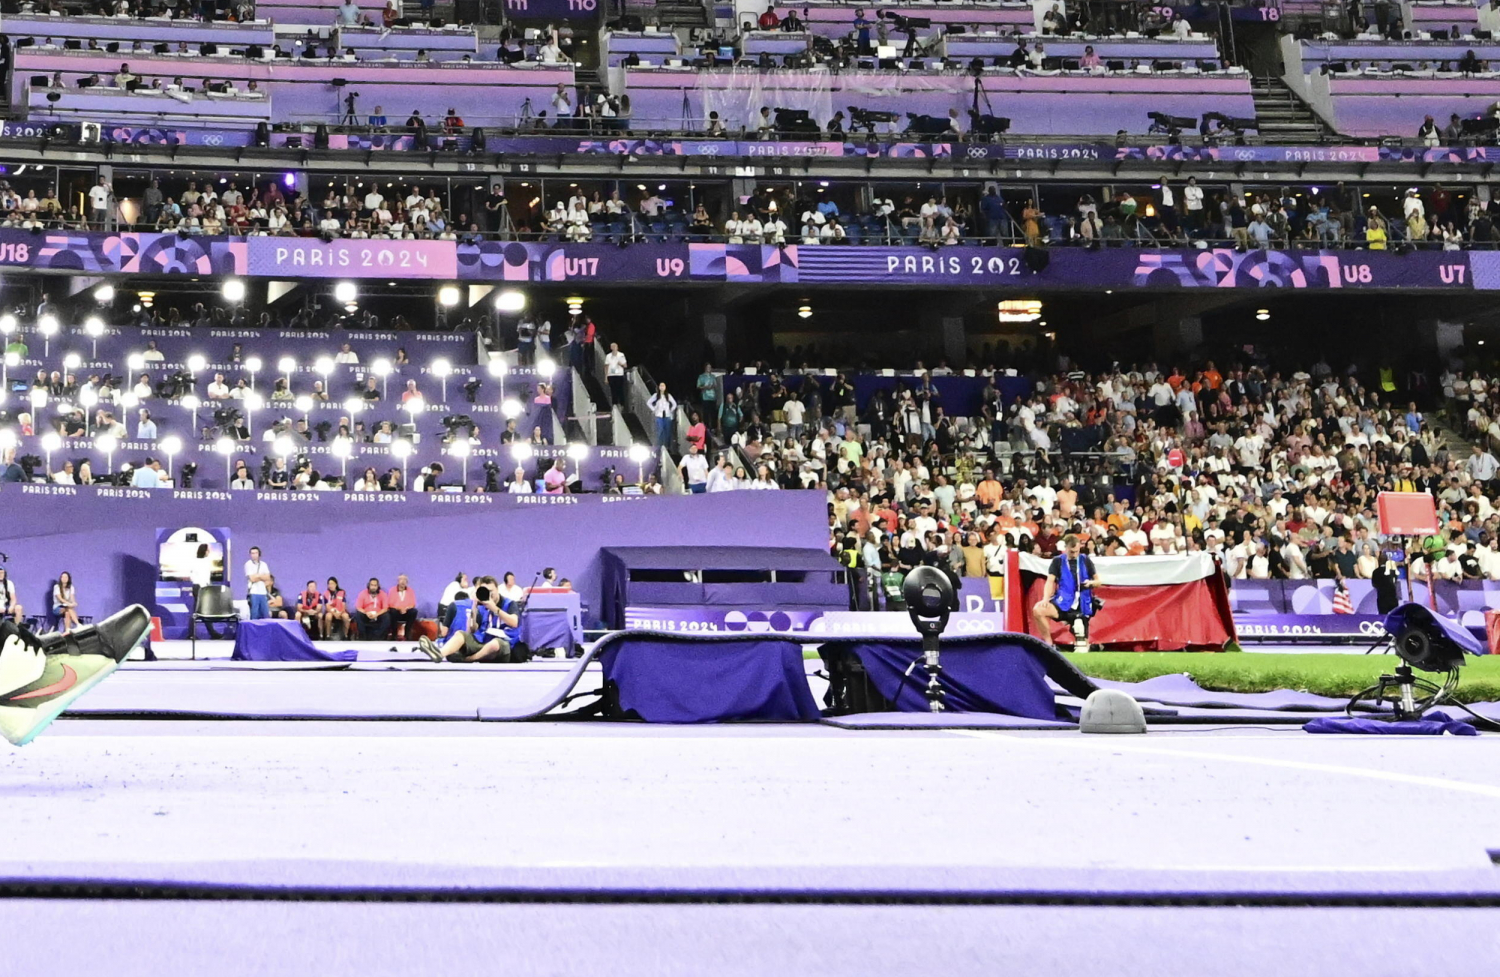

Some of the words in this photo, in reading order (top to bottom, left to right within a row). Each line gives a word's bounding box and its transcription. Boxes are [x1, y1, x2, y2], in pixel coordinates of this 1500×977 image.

[1259, 7, 1279, 21] T8
[15, 126, 43, 138] 202
[749, 145, 788, 157] PARIS
[1018, 148, 1058, 160] PARIS
[1063, 149, 1099, 160] 2024
[1285, 149, 1326, 161] PARIS
[1329, 150, 1366, 161] 2024
[466, 163, 476, 171] 13
[276, 248, 350, 266] PARIS
[361, 249, 428, 268] 2024
[565, 257, 599, 276] U17
[656, 258, 684, 277] U9
[887, 256, 961, 274] PARIS
[971, 257, 1037, 275] 202
[1343, 264, 1372, 284] U8
[1440, 264, 1465, 285] U7
[375, 333, 397, 341] 2024
[416, 334, 440, 342] PARIS
[121, 442, 148, 451] PARIS
[23, 485, 50, 494] PARIS
[52, 486, 77, 495] 2024
[97, 488, 124, 497] PARIS
[126, 489, 150, 498] 2024
[174, 490, 202, 499] PARIS
[206, 491, 231, 500] 2024
[257, 493, 288, 501] PARIS
[291, 493, 319, 501] 2024
[344, 493, 375, 502] PARIS
[378, 494, 406, 502] 2024
[431, 495, 461, 503] PARIS
[465, 495, 492, 503] 2024
[517, 496, 547, 504] PARIS
[550, 496, 578, 504] 2024
[633, 619, 675, 631] PARIS
[680, 621, 717, 632] 2024
[1237, 624, 1278, 635] PARIS
[1284, 625, 1321, 635] 2024
